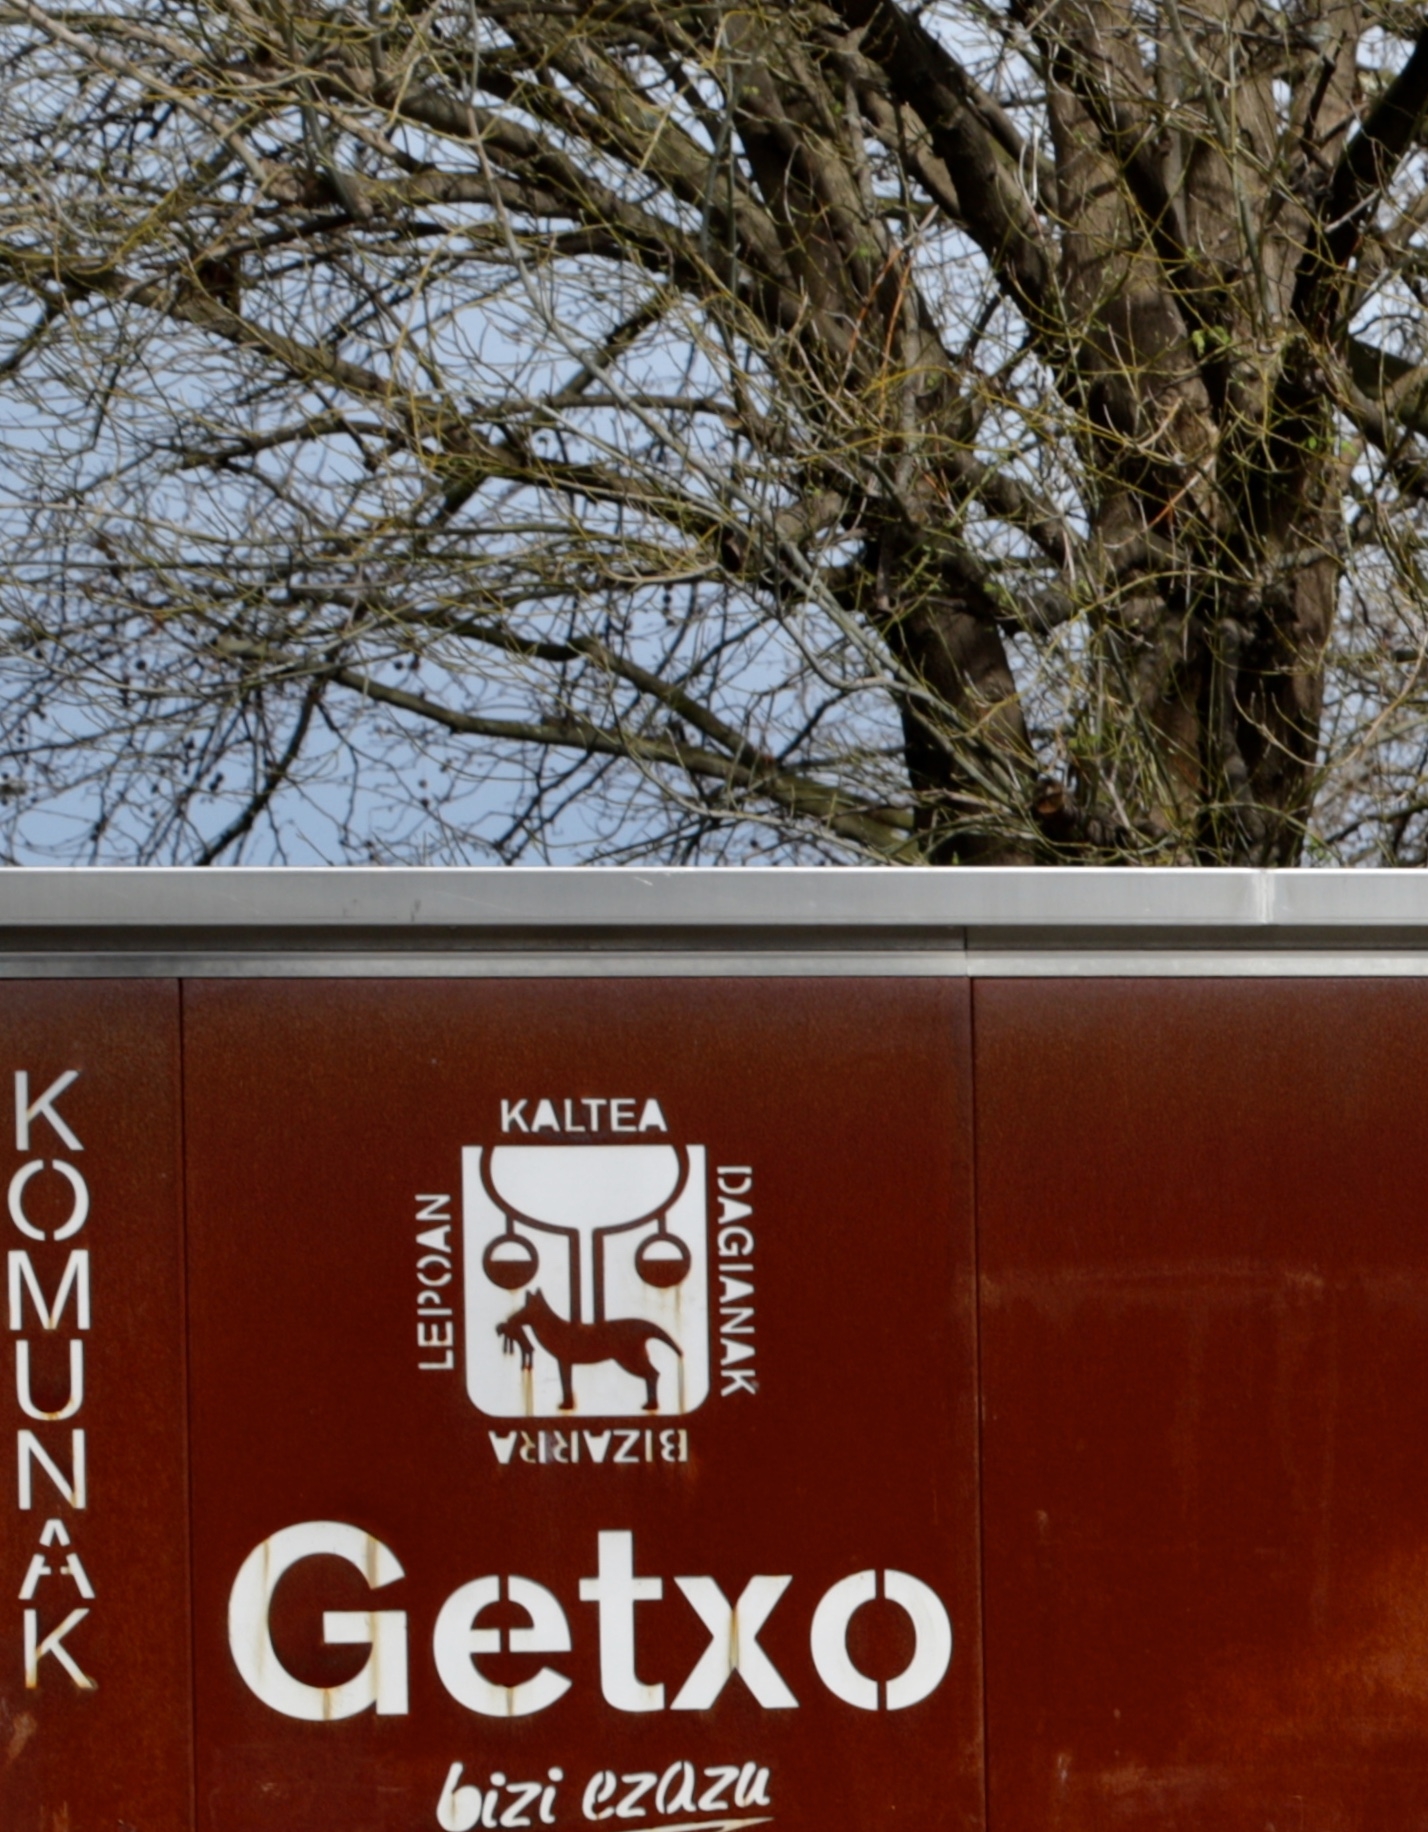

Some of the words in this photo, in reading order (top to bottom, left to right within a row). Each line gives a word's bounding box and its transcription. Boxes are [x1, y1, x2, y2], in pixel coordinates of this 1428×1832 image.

[499, 1097, 668, 1133] KALTEA
[415, 1193, 454, 1372] LEPOAN
[716, 1165, 759, 1398] DAGIANAK
[6, 1069, 98, 1691] KOMUNAK
[488, 1429, 688, 1464] BIZARRA
[228, 1519, 954, 1721] Getxo
[435, 1761, 563, 1832] bizi
[582, 1760, 772, 1821] ezazu
